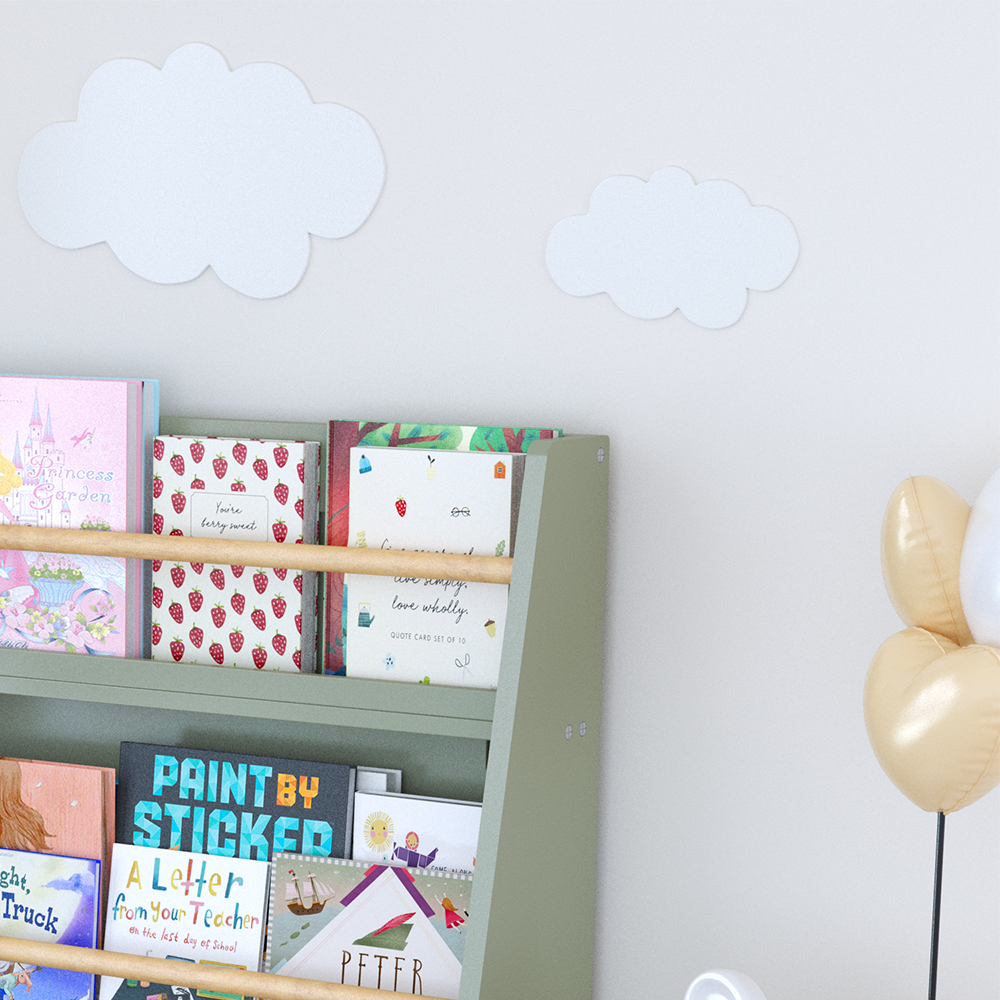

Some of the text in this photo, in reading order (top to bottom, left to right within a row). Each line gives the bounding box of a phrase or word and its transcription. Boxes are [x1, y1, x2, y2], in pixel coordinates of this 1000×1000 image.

[27, 455, 114, 481] Princess
[29, 483, 111, 510] Garden
[216, 501, 243, 514] You're
[201, 517, 257, 534] berry sweet
[391, 595, 468, 624] love wholly.
[390, 631, 412, 640] QUOTE
[414, 633, 431, 641] CARD
[433, 635, 445, 643] SET
[458, 637, 466, 645] 10
[152, 754, 320, 809] PAINT BY
[133, 800, 333, 861] STICKER
[126, 857, 244, 899] A Letter
[1, 891, 59, 934] Truck
[112, 892, 147, 921] from
[189, 901, 259, 929] Teacher
[129, 926, 139, 935] on
[142, 927, 157, 939] the
[160, 927, 179, 943] last
[183, 933, 198, 949] day
[200, 939, 211, 950] of
[341, 950, 423, 995] PETER
